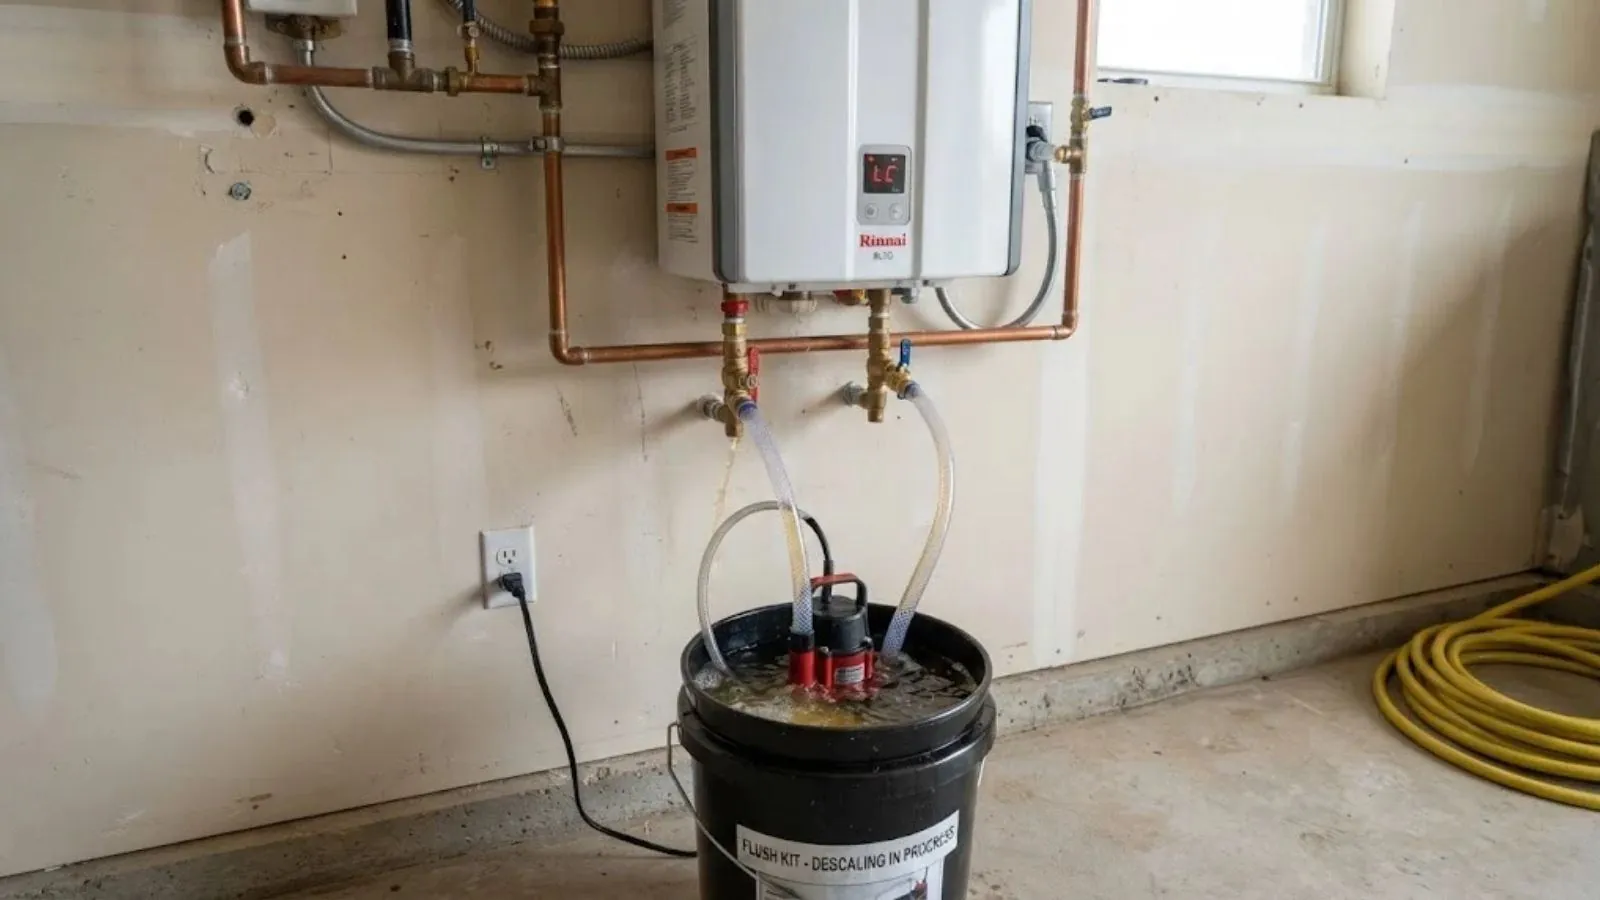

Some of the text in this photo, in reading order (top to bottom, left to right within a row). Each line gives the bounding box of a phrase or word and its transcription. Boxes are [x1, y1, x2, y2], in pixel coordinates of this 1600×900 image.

[860, 233, 906, 248] Rinnai
[742, 838, 777, 863] FLUSH
[780, 851, 801, 867] KIT
[811, 854, 886, 872] DESCALING
[889, 850, 901, 866] IN
